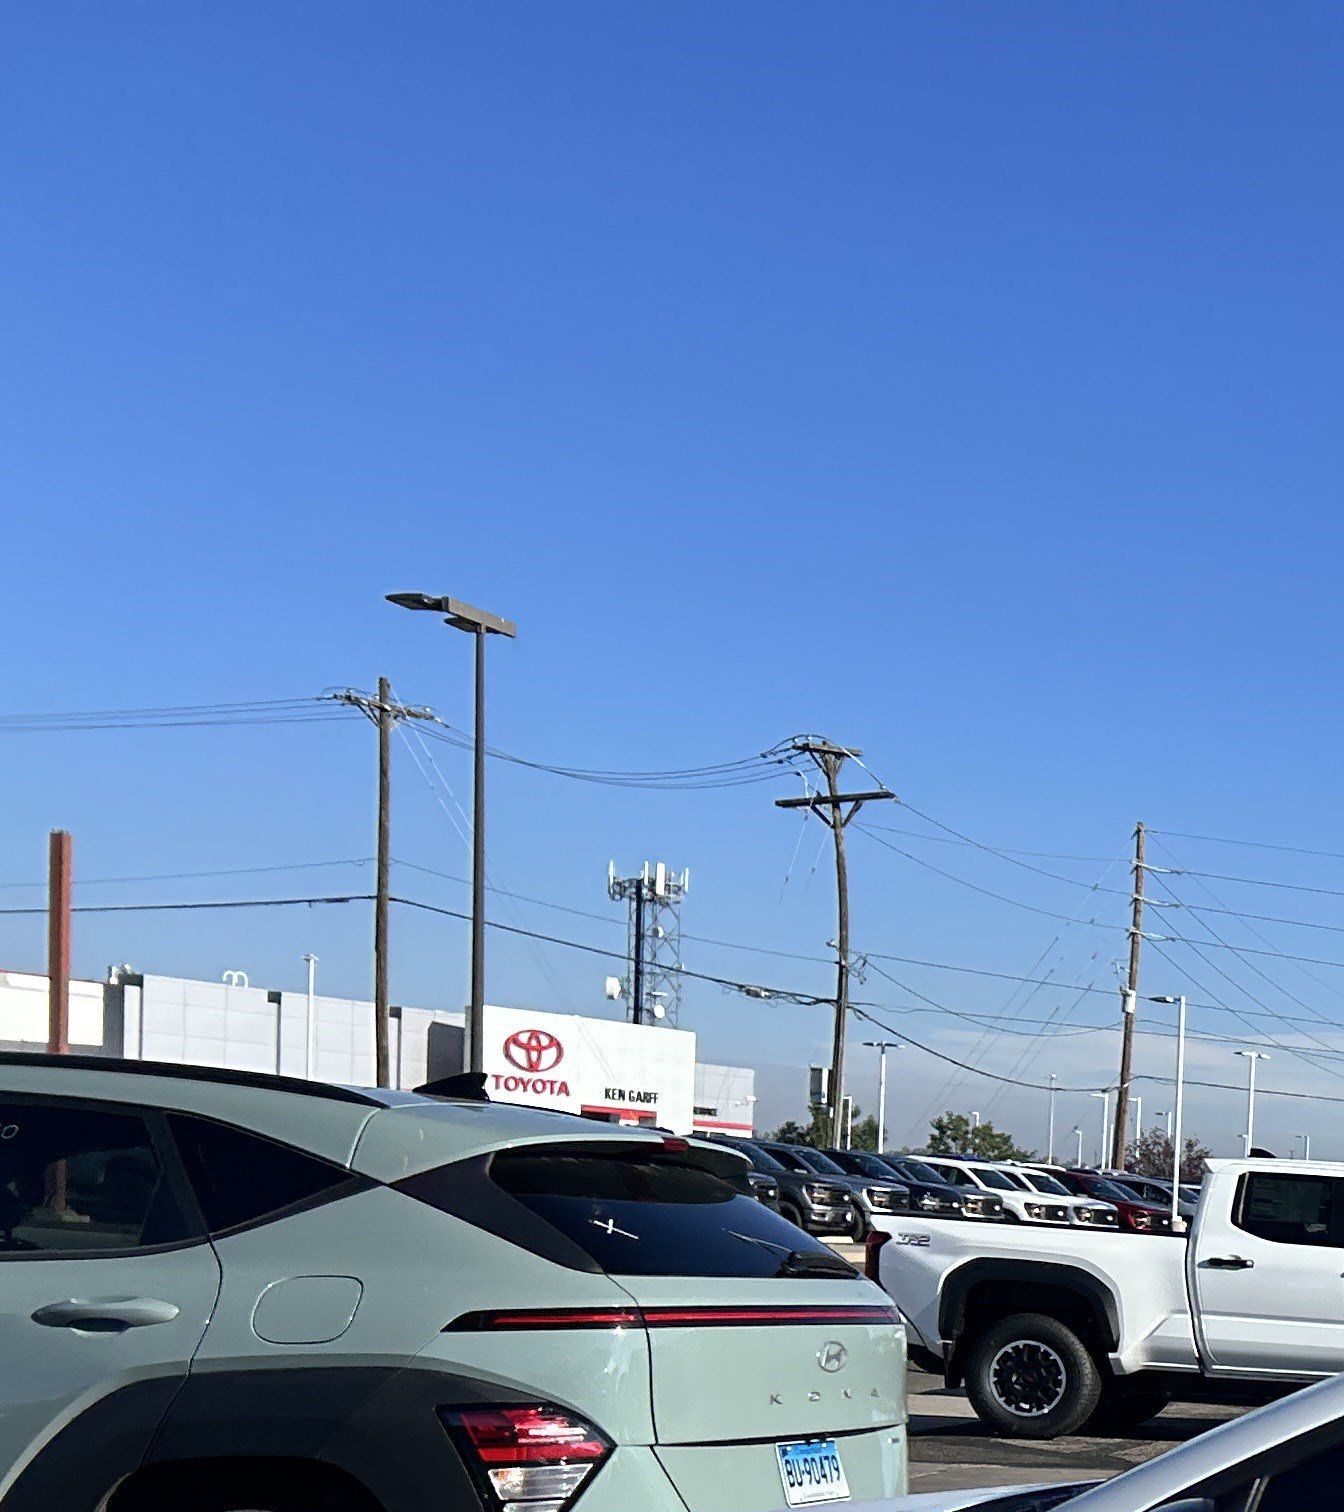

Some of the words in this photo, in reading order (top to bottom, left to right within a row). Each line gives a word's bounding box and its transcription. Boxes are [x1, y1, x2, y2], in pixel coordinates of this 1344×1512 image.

[491, 1074, 571, 1097] TOYOTA
[604, 1087, 626, 1102] KEN
[628, 1089, 659, 1105] GARFF
